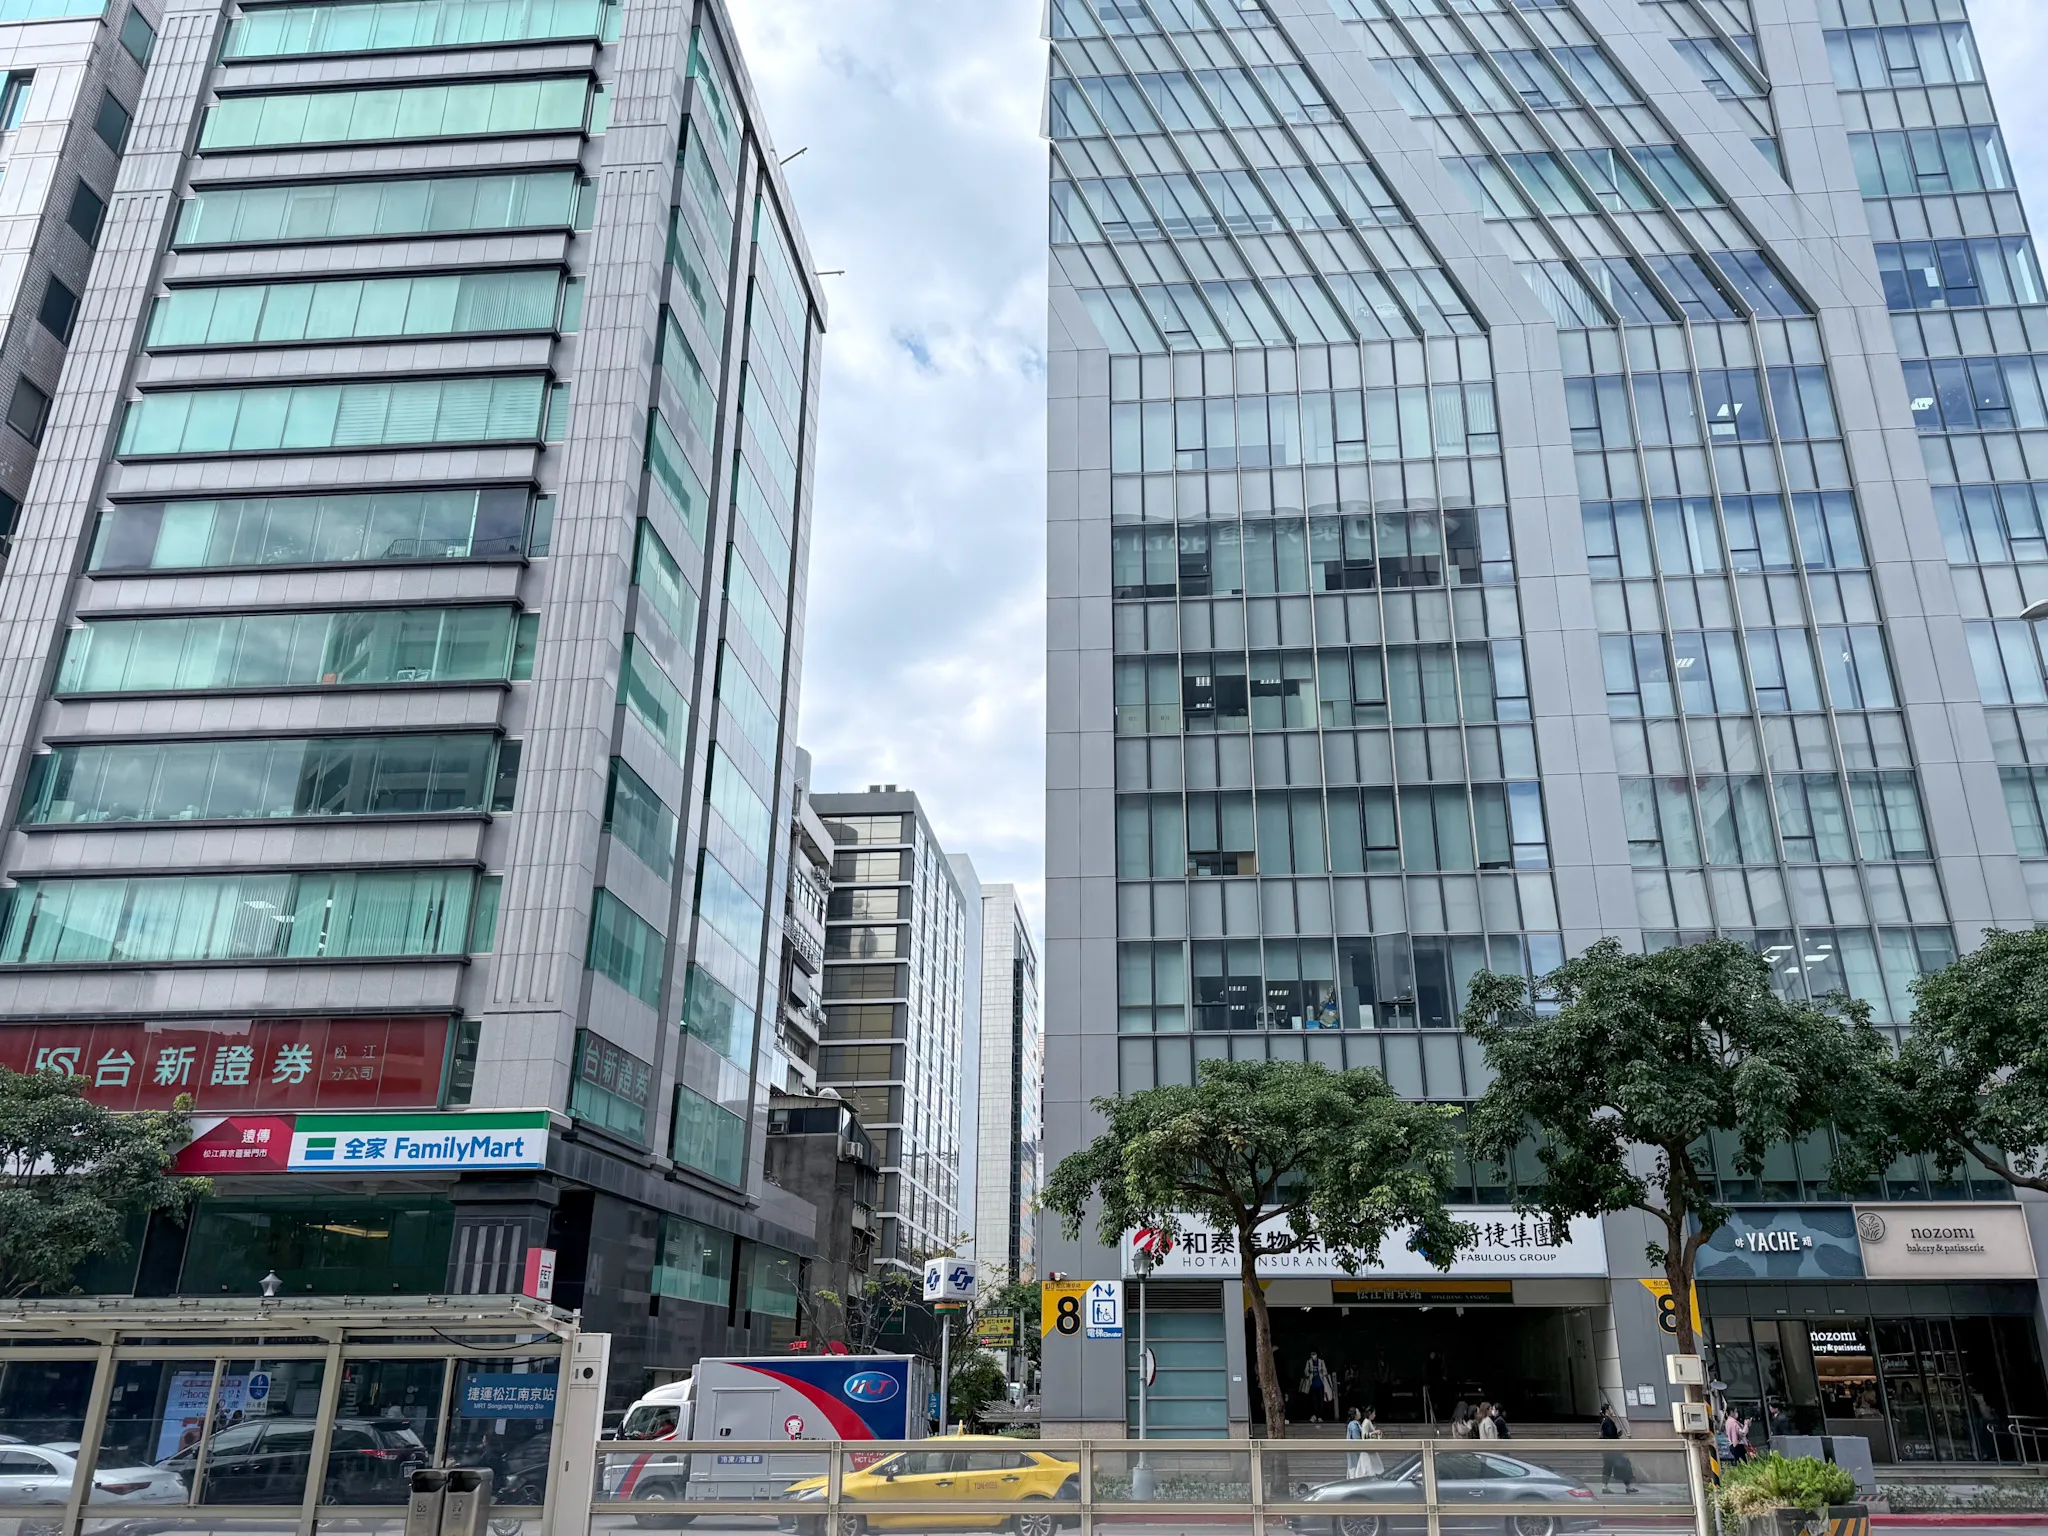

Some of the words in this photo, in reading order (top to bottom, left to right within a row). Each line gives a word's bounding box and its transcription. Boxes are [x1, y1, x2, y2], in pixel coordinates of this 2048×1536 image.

[335, 1045, 376, 1059] 松江
[95, 1043, 312, 1087] 台新證券
[584, 1040, 649, 1101] 台新證券
[331, 1066, 374, 1080] 分公司
[242, 1129, 271, 1143] 遠傳
[343, 1138, 387, 1159] 全家
[394, 1136, 524, 1161] FamilyMart
[1911, 1228, 1975, 1239] nozomi
[1746, 1231, 1800, 1252] YACHE
[1183, 1256, 1236, 1267] HOTAI
[1258, 1256, 1338, 1267] NSURANC
[541, 1269, 551, 1280] FET
[1056, 1296, 1081, 1335] 8
[1810, 1331, 1857, 1341] nozomi
[467, 1386, 555, 1401] 捷運松江南京站
[854, 1456, 868, 1465] HCT
